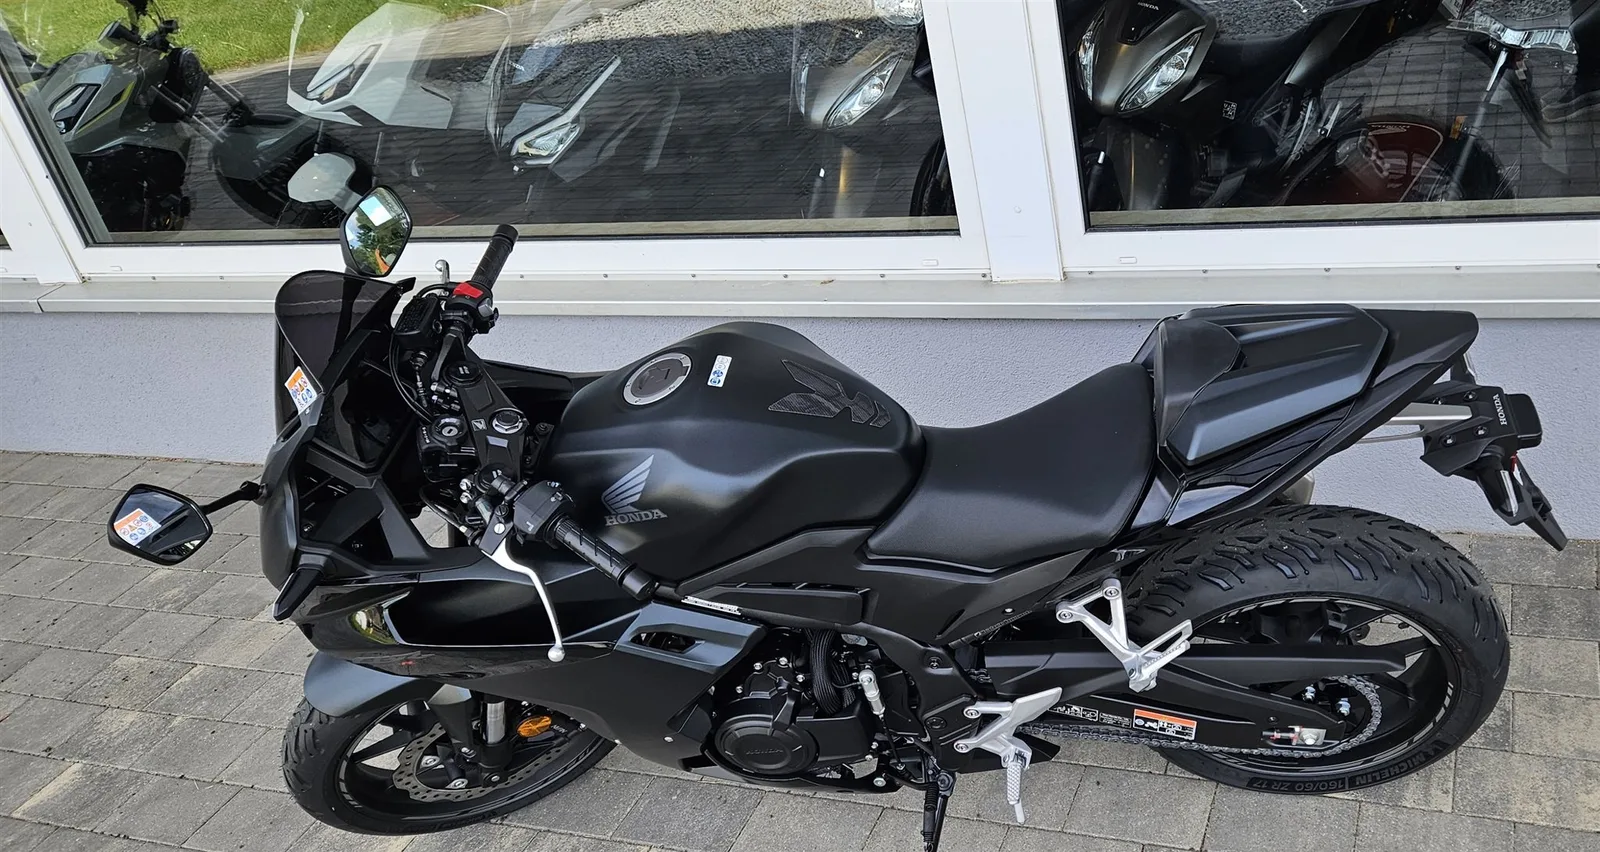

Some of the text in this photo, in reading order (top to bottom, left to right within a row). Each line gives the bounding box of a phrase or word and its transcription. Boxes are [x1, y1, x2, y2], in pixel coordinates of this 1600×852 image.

[1493, 393, 1507, 425] HONDA
[604, 508, 668, 526] HONDA
[1252, 752, 1426, 791] MICHELIN 160/60 ZR 17
